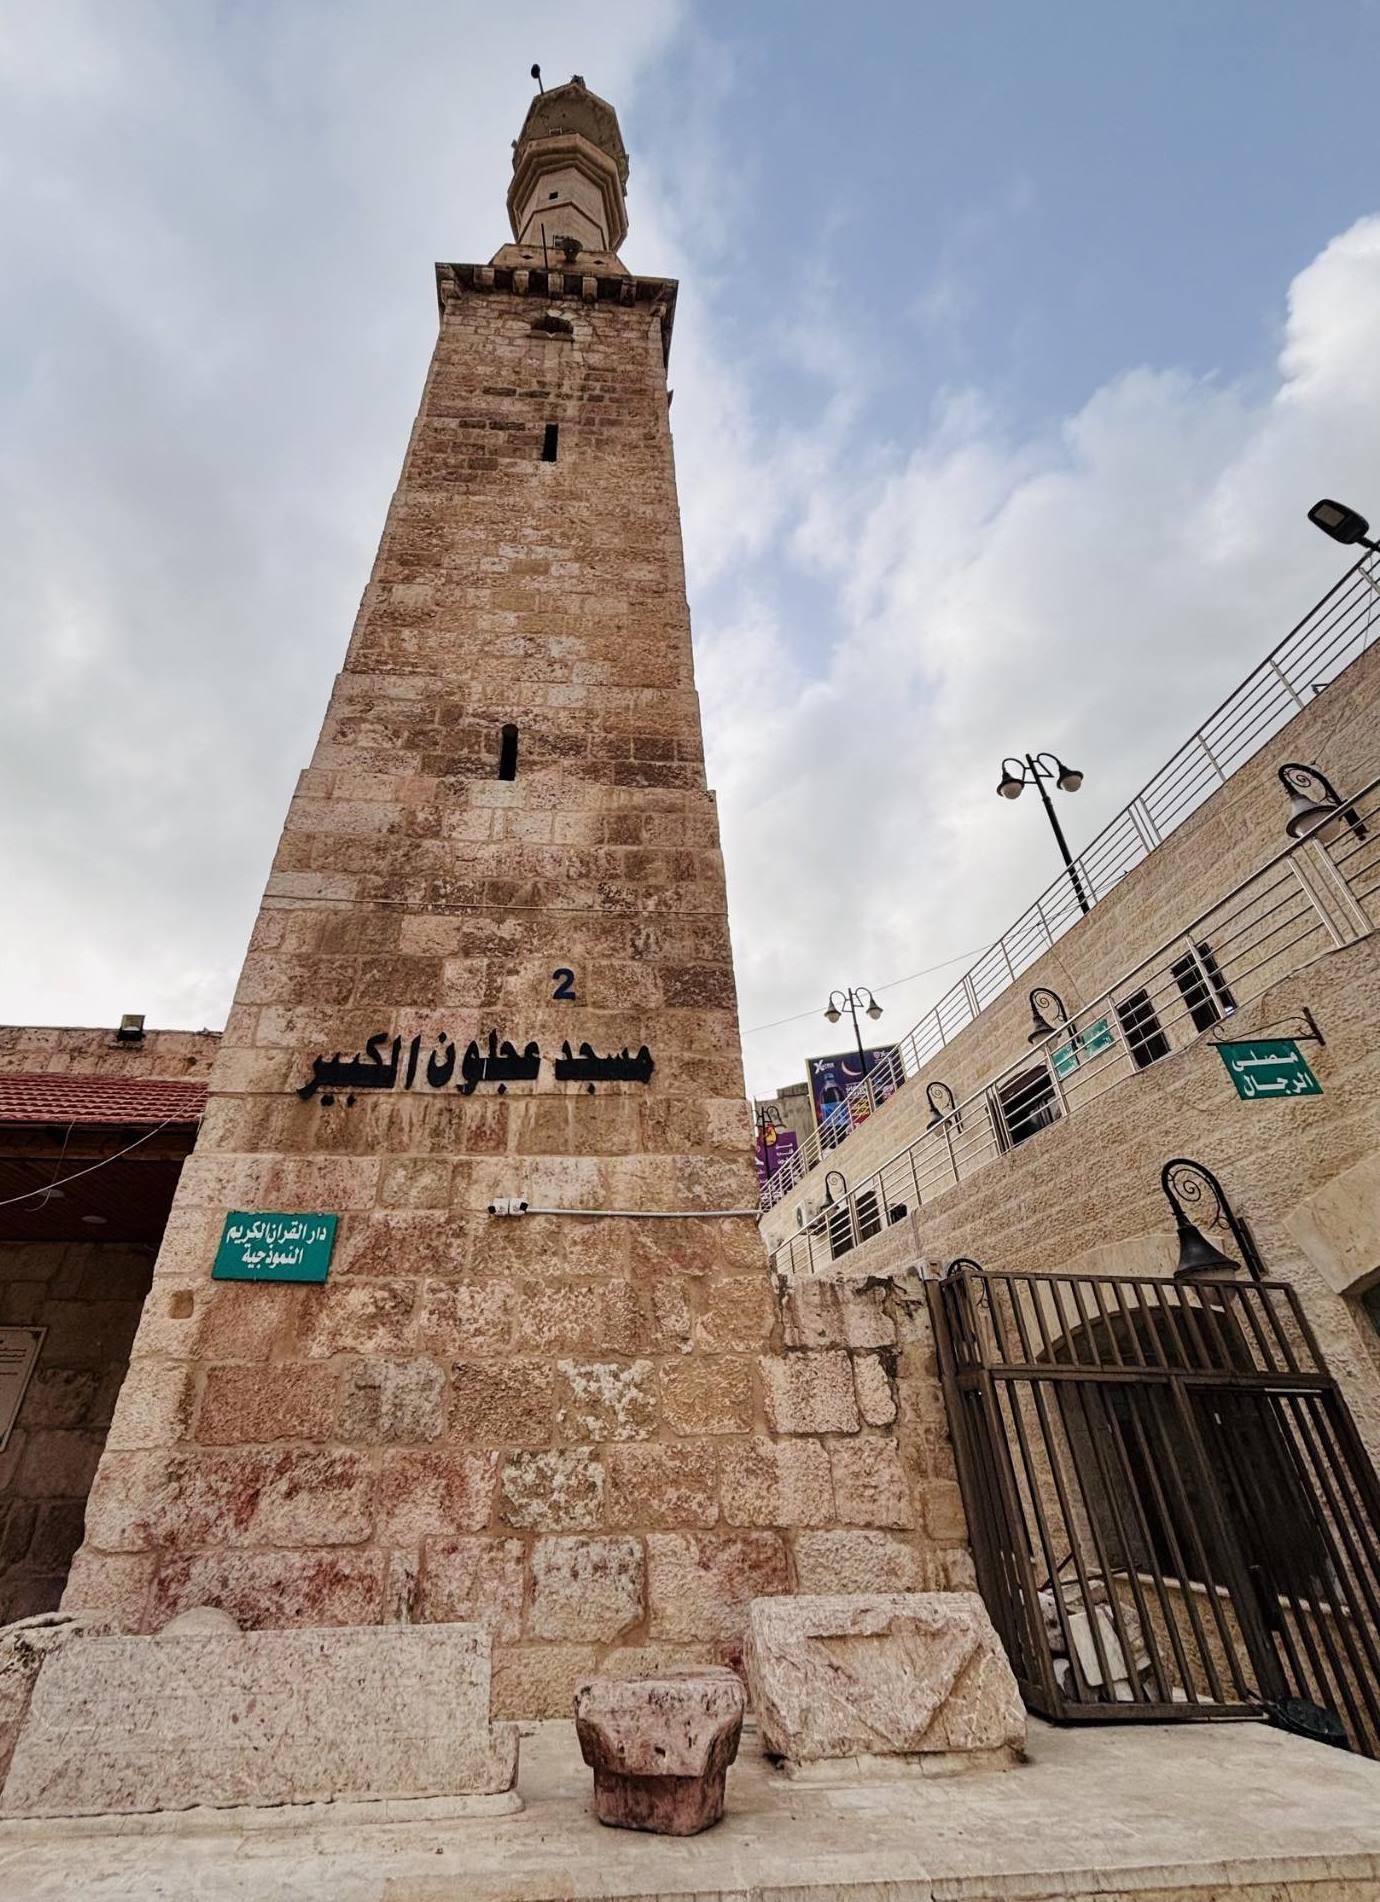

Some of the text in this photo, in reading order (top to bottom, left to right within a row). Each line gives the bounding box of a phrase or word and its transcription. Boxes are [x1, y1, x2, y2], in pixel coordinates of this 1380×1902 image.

[552, 968, 576, 1000] 2
[296, 1030, 655, 1108] مسجد عجلون الكبير
[1243, 1071, 1314, 1097] الرجال
[226, 1221, 271, 1244] الكريم
[306, 1226, 327, 1244] دار
[241, 1243, 304, 1269] النموذجية
